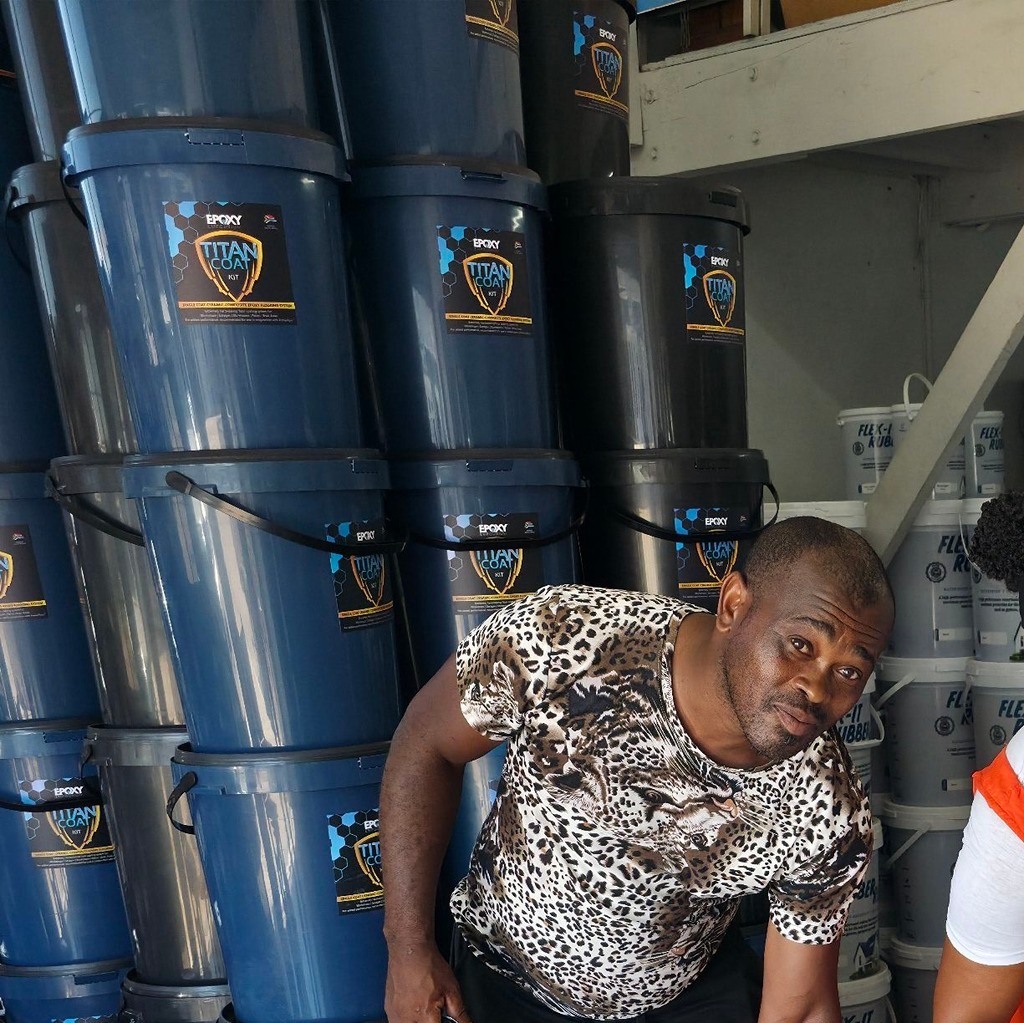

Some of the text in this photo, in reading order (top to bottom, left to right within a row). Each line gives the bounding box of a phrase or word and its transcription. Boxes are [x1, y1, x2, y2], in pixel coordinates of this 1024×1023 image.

[206, 214, 243, 226] EPOXY
[473, 238, 501, 250] EPOXY
[200, 241, 258, 261] TITAN
[211, 258, 251, 271] COAT
[710, 256, 730, 267] EPOXY
[467, 262, 511, 280] TITAN
[475, 276, 505, 288] COAT
[706, 278, 735, 295] TITAN
[858, 424, 893, 437] FLEX-I
[704, 517, 728, 526] EPOXY
[479, 523, 508, 533] EPOXY
[356, 531, 375, 541] EPOXY
[705, 549, 731, 560] COAT
[353, 555, 383, 571] TITAN
[481, 559, 513, 569] COAT
[54, 786, 84, 796] EPOXY
[58, 817, 90, 828] COAT
[364, 819, 380, 830] EPO
[358, 841, 381, 857] TIT
[366, 855, 382, 866] CO
